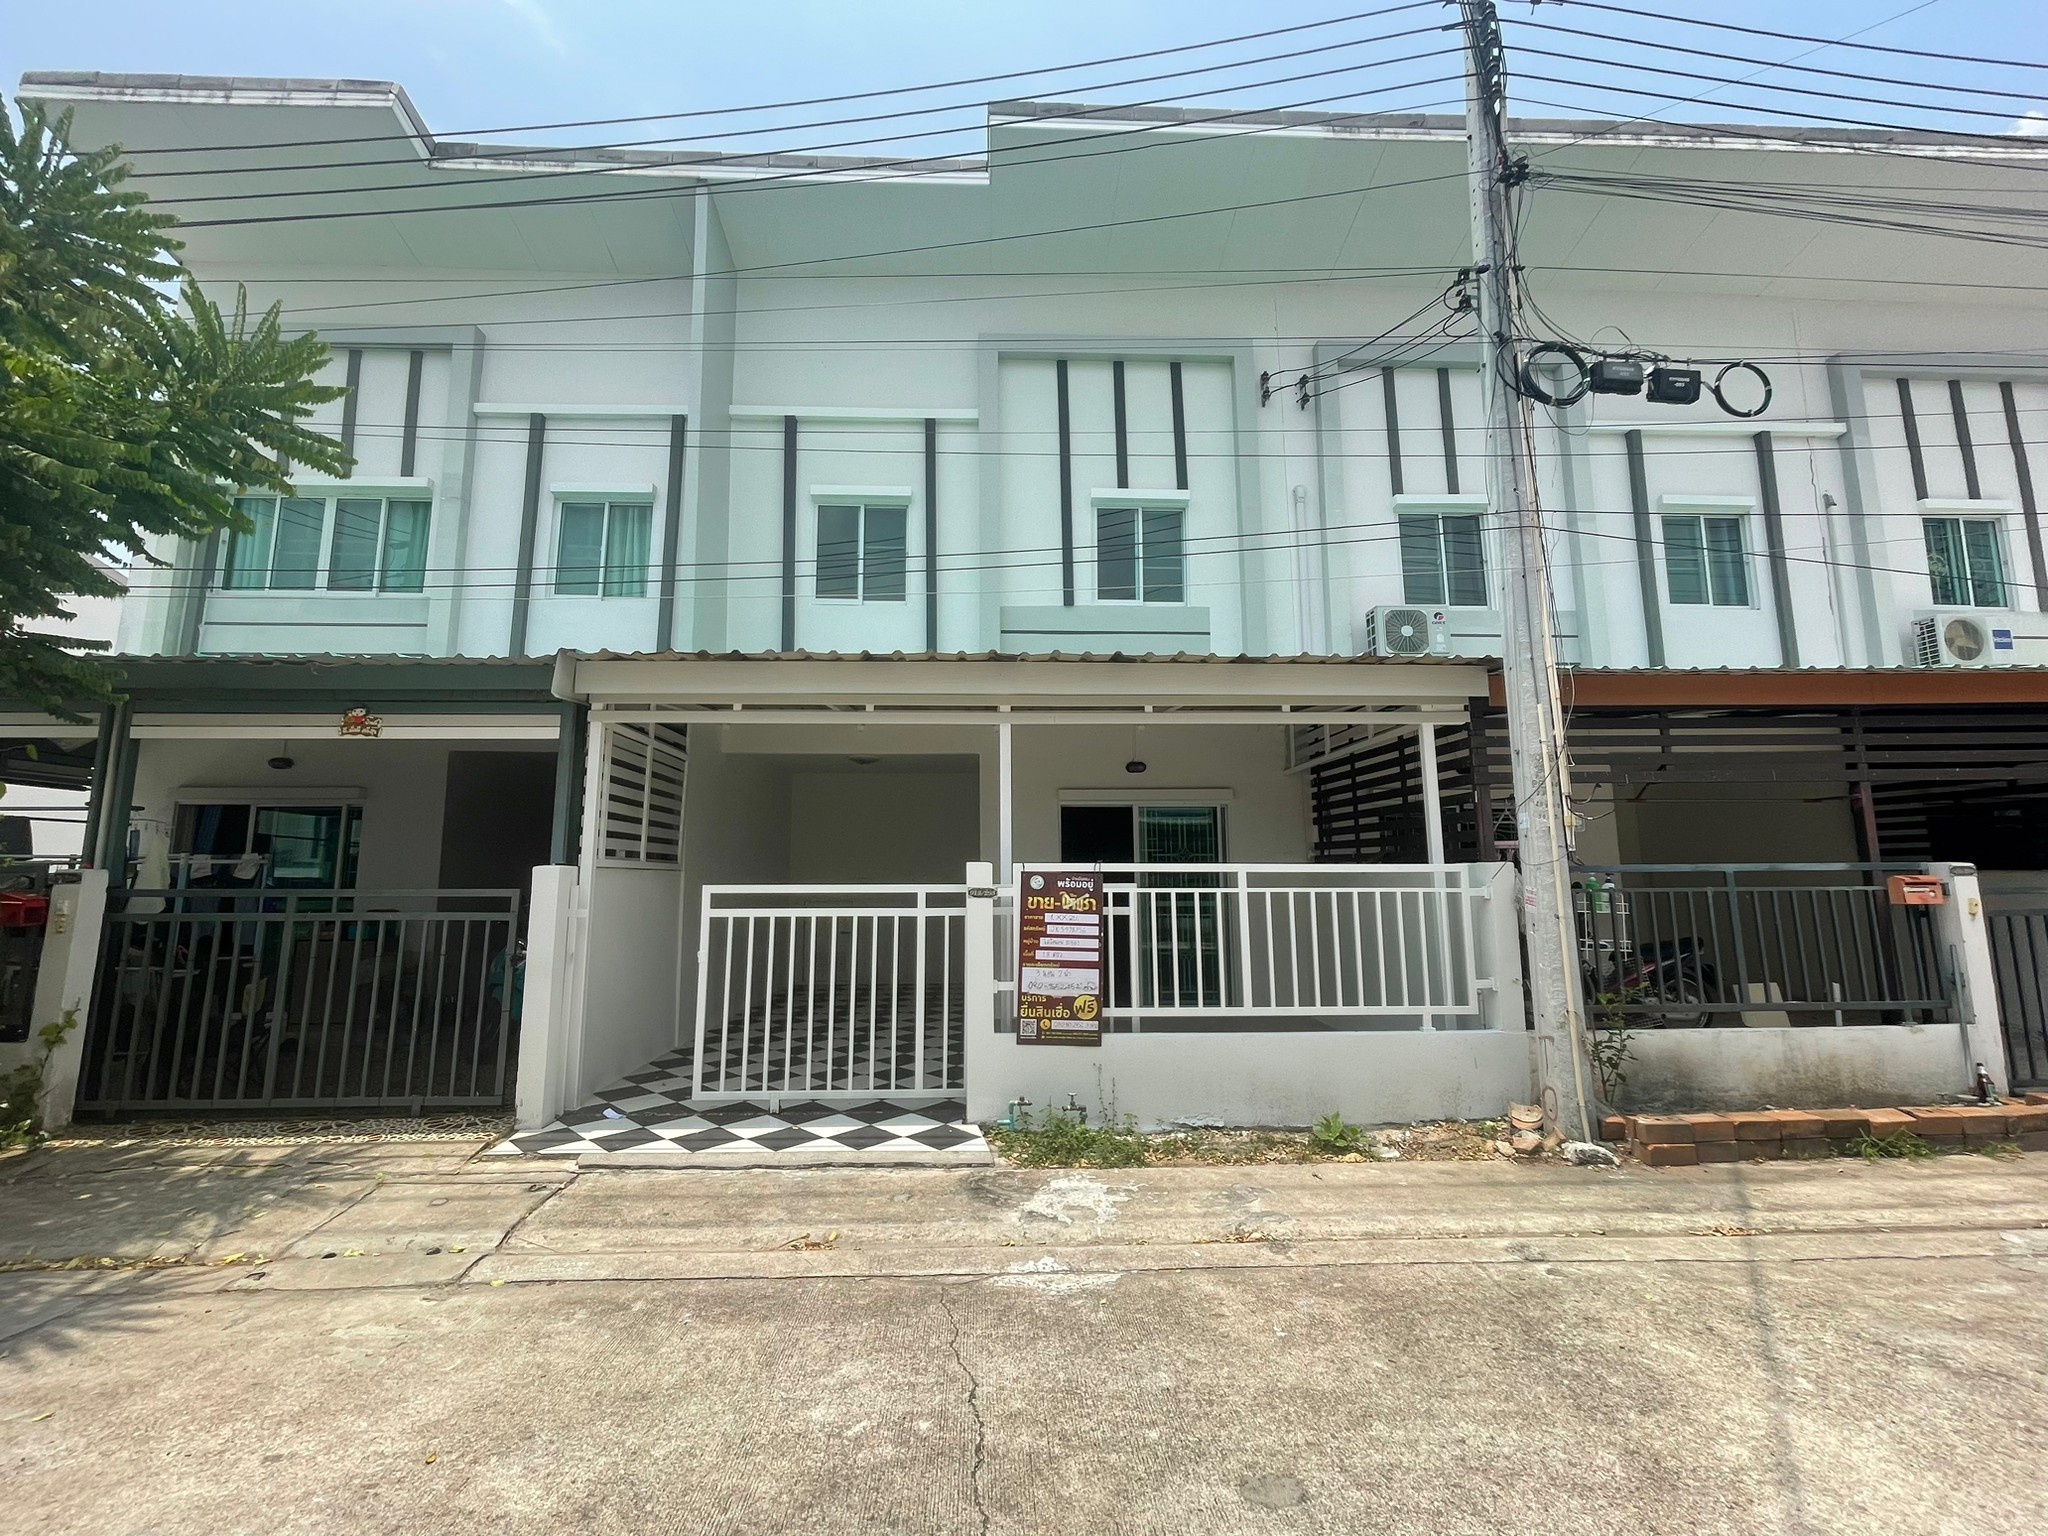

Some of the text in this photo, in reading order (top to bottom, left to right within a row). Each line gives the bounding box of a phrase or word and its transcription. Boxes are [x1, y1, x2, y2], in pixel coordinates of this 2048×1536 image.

[1057, 877, 1094, 892] พร้อมอยู่
[1021, 994, 1047, 1002] บรการ
[1020, 1002, 1071, 1018] ยื่นสินเชื่อ
